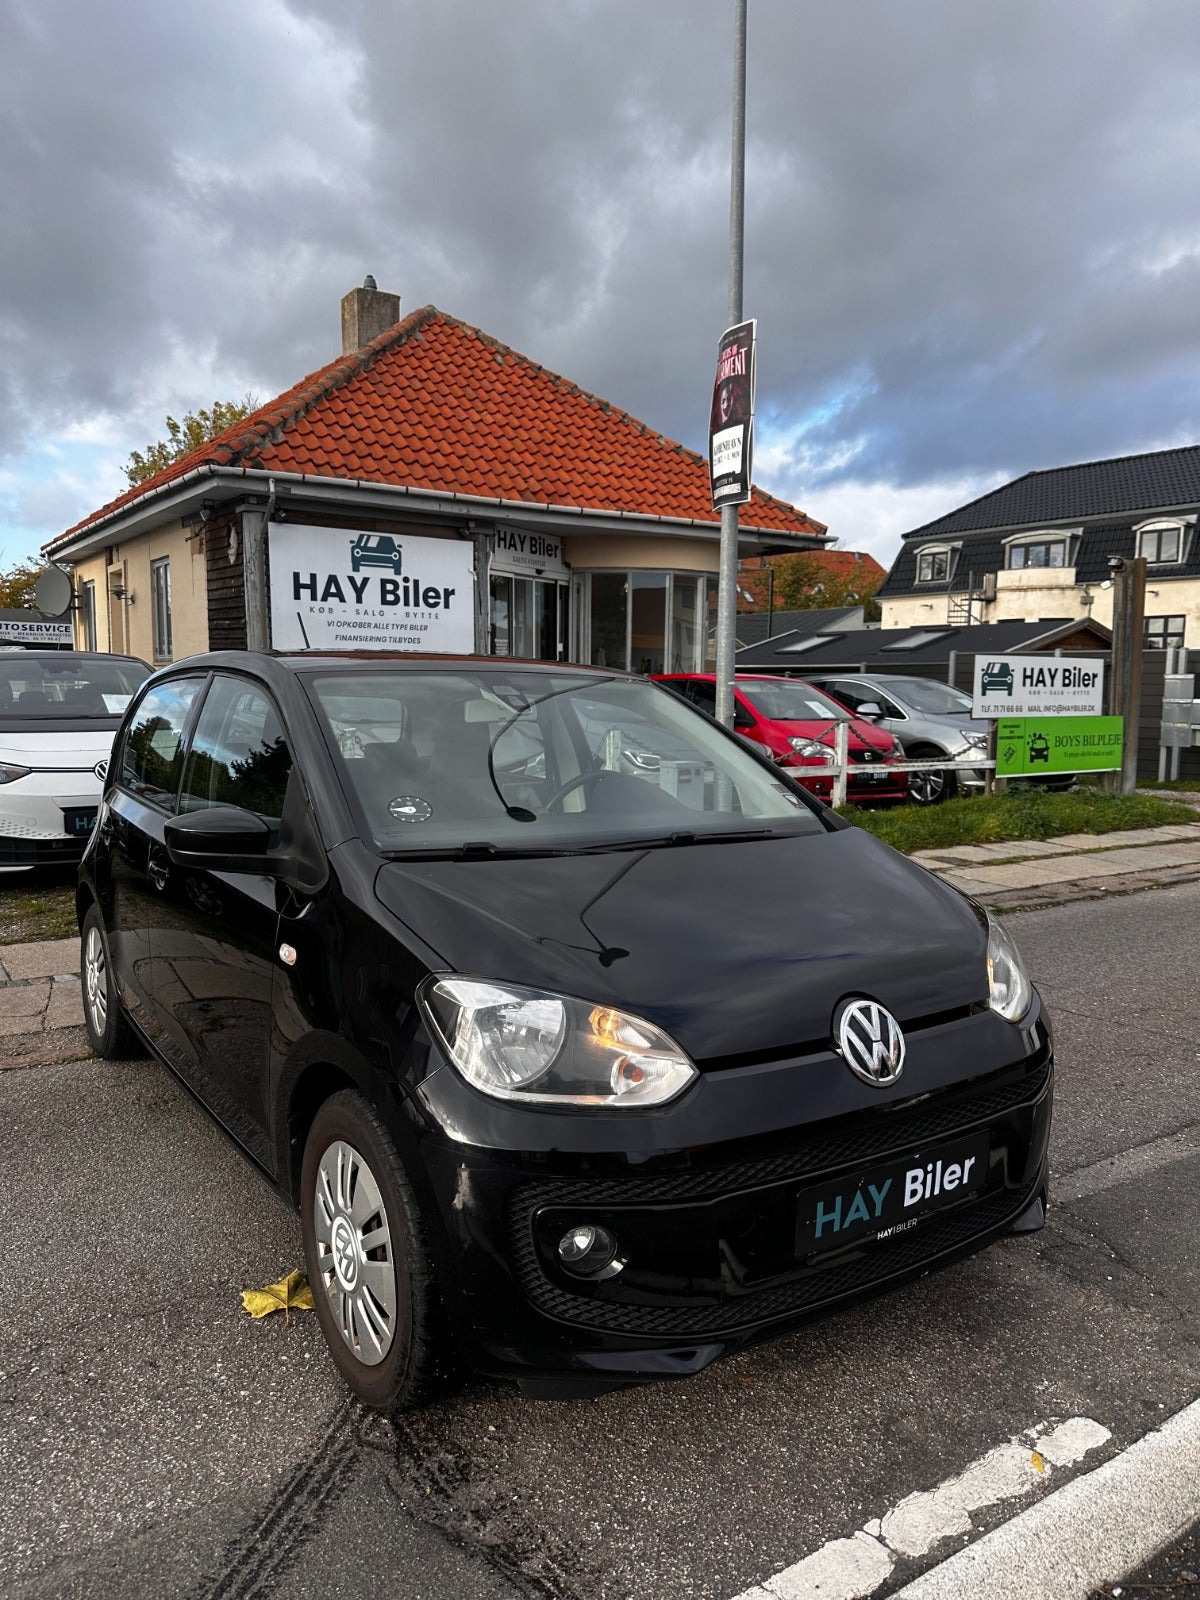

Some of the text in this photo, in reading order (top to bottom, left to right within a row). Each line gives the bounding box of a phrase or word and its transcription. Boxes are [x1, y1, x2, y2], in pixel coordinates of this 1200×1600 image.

[497, 530, 560, 559] HAY Biler
[292, 571, 455, 609] HAY Biler
[309, 606, 334, 614] KØB
[355, 609, 385, 617] SALG
[405, 611, 440, 620] BYTTE
[0, 623, 71, 632] TOSERVICE
[336, 620, 372, 629] OPKØBER
[373, 622, 390, 630] ALLE
[391, 623, 408, 631] TYPE
[409, 624, 428, 632] BILER
[335, 634, 421, 644] FINANSIERING TILBYDES
[1022, 666, 1098, 688] HAY Biler
[1054, 733, 1122, 748] BOYS BILPLEJE
[815, 1155, 976, 1239] HAY Biler
